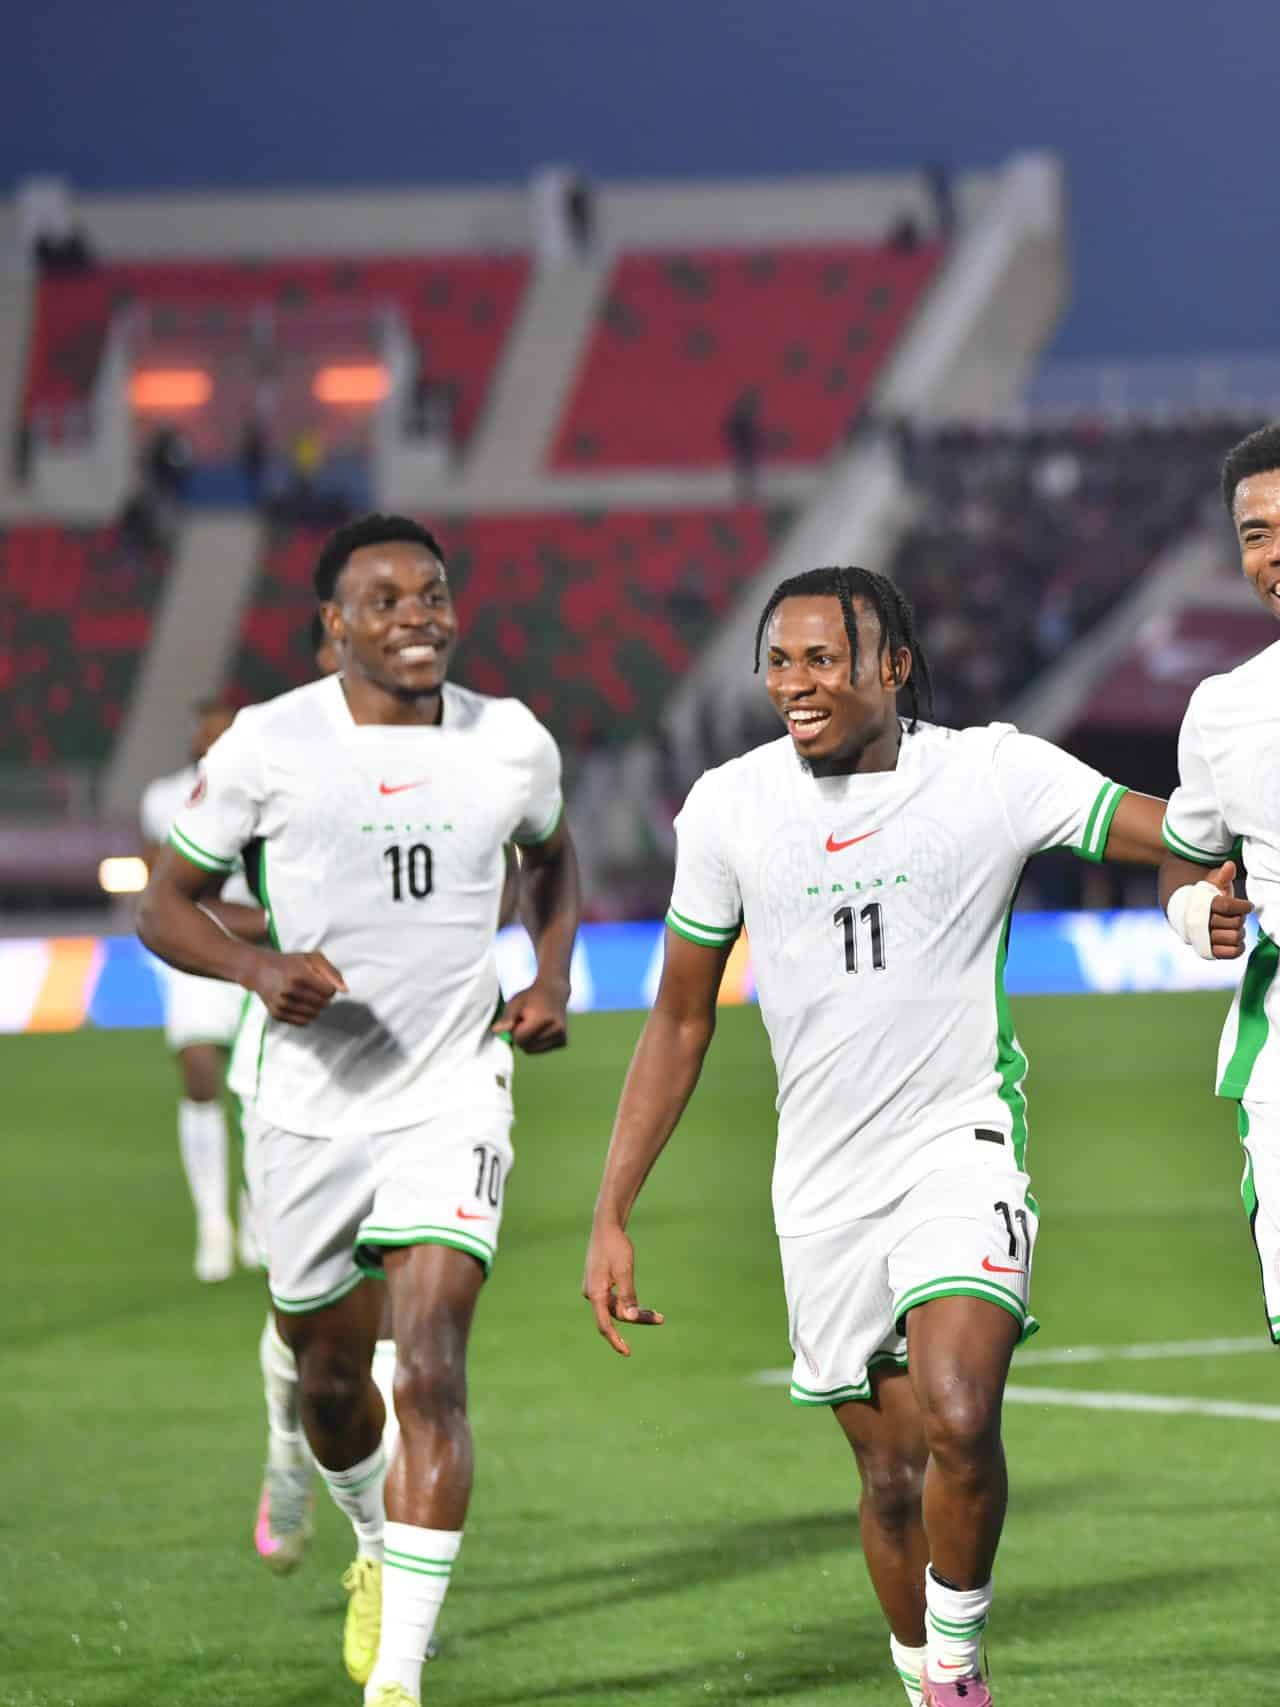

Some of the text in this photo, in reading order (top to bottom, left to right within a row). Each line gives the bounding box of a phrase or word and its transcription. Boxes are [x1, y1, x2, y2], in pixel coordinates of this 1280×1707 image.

[384, 842, 434, 902] 10
[806, 874, 908, 896] NAIJA
[833, 902, 886, 975] 11
[473, 1146, 501, 1208] 10
[994, 1200, 1030, 1272] 11
